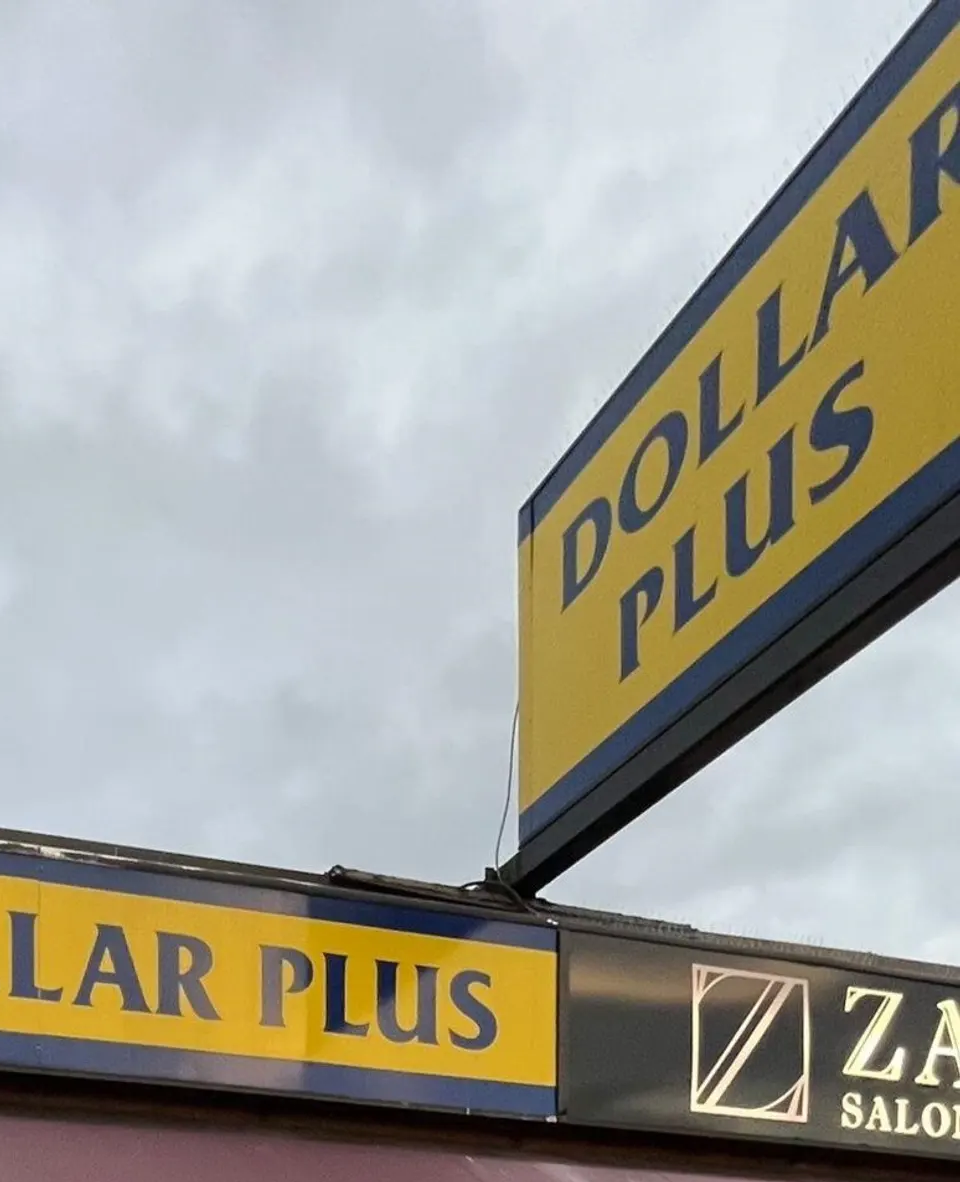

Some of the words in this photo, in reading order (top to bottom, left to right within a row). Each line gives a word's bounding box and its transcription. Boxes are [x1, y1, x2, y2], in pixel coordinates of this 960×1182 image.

[619, 358, 875, 684] PLUS
[258, 943, 499, 1051] PLUS
[841, 1091, 960, 1139] SALO
